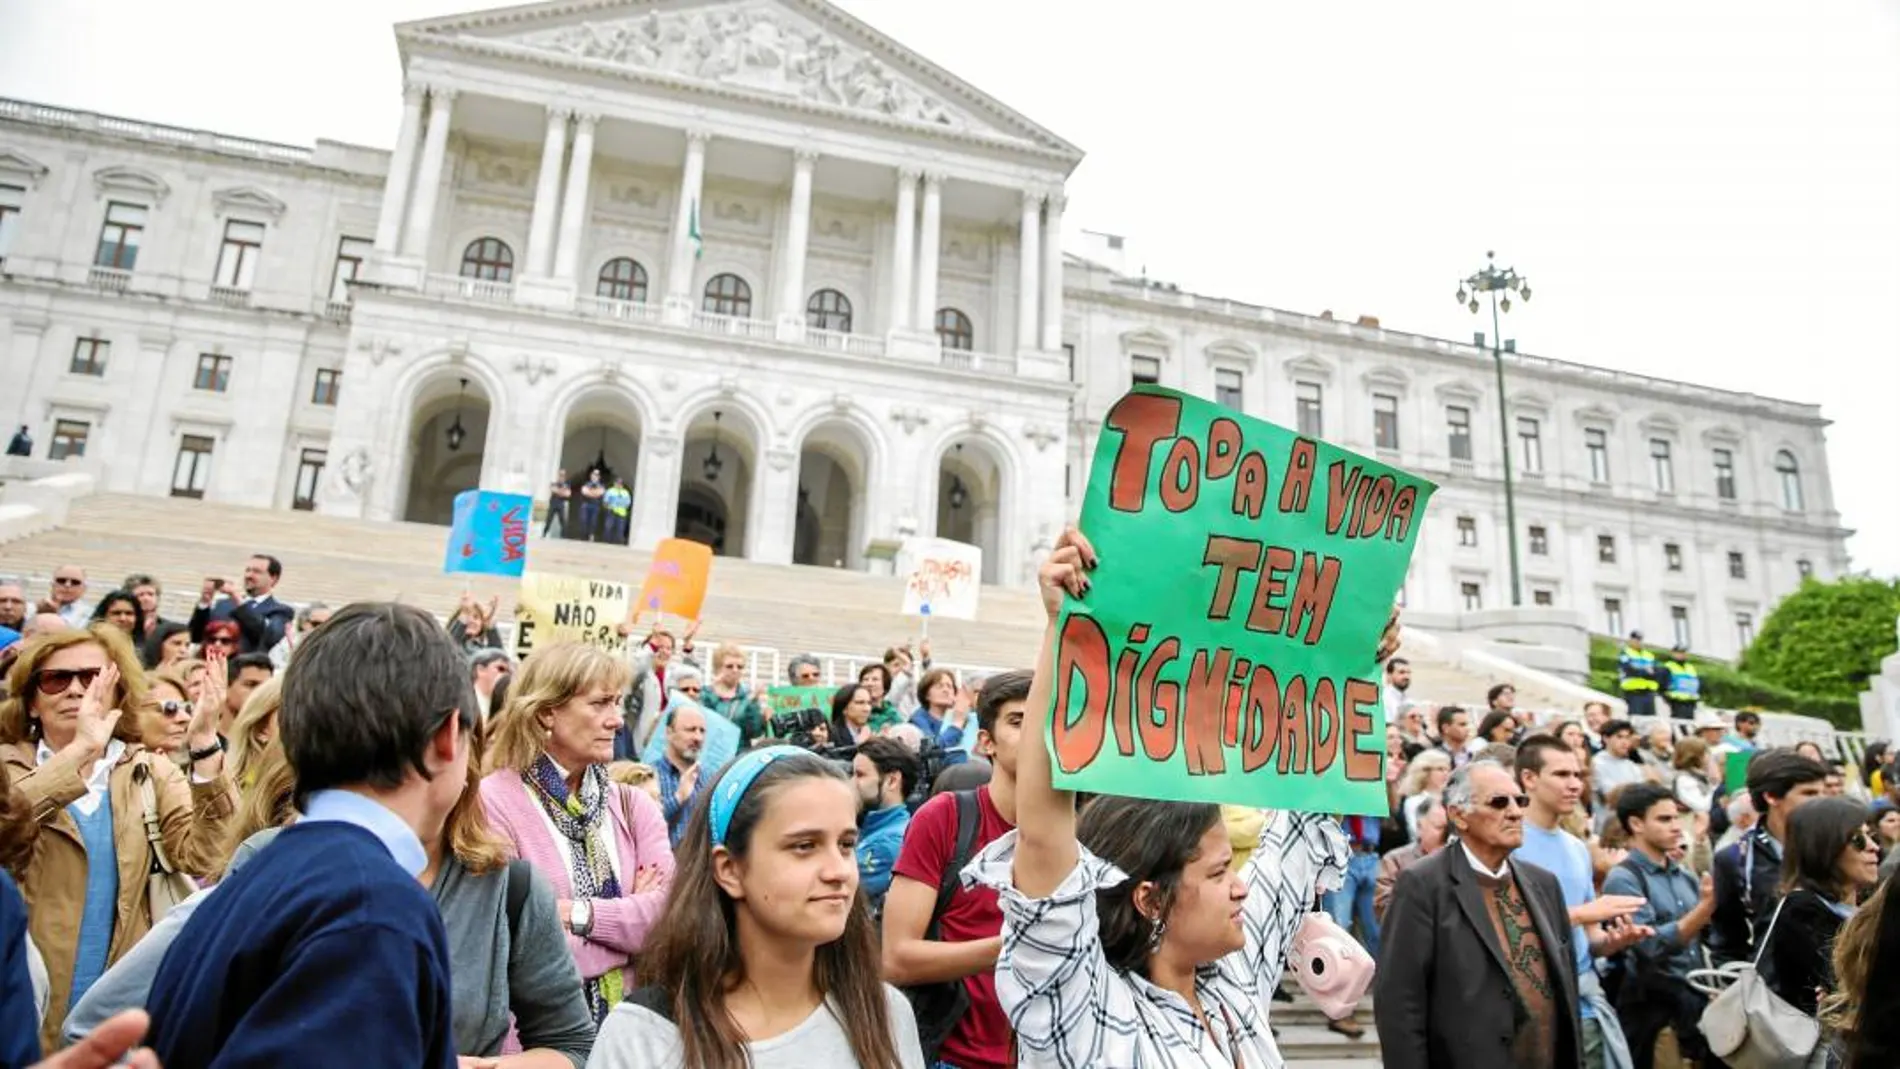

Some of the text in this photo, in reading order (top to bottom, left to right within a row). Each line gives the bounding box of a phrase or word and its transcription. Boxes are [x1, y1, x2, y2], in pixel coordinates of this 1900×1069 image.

[1106, 394, 1417, 541] TODA A VIDA
[554, 599, 596, 627] NÃO
[589, 581, 623, 600] VIDA
[1202, 534, 1342, 644] TEM
